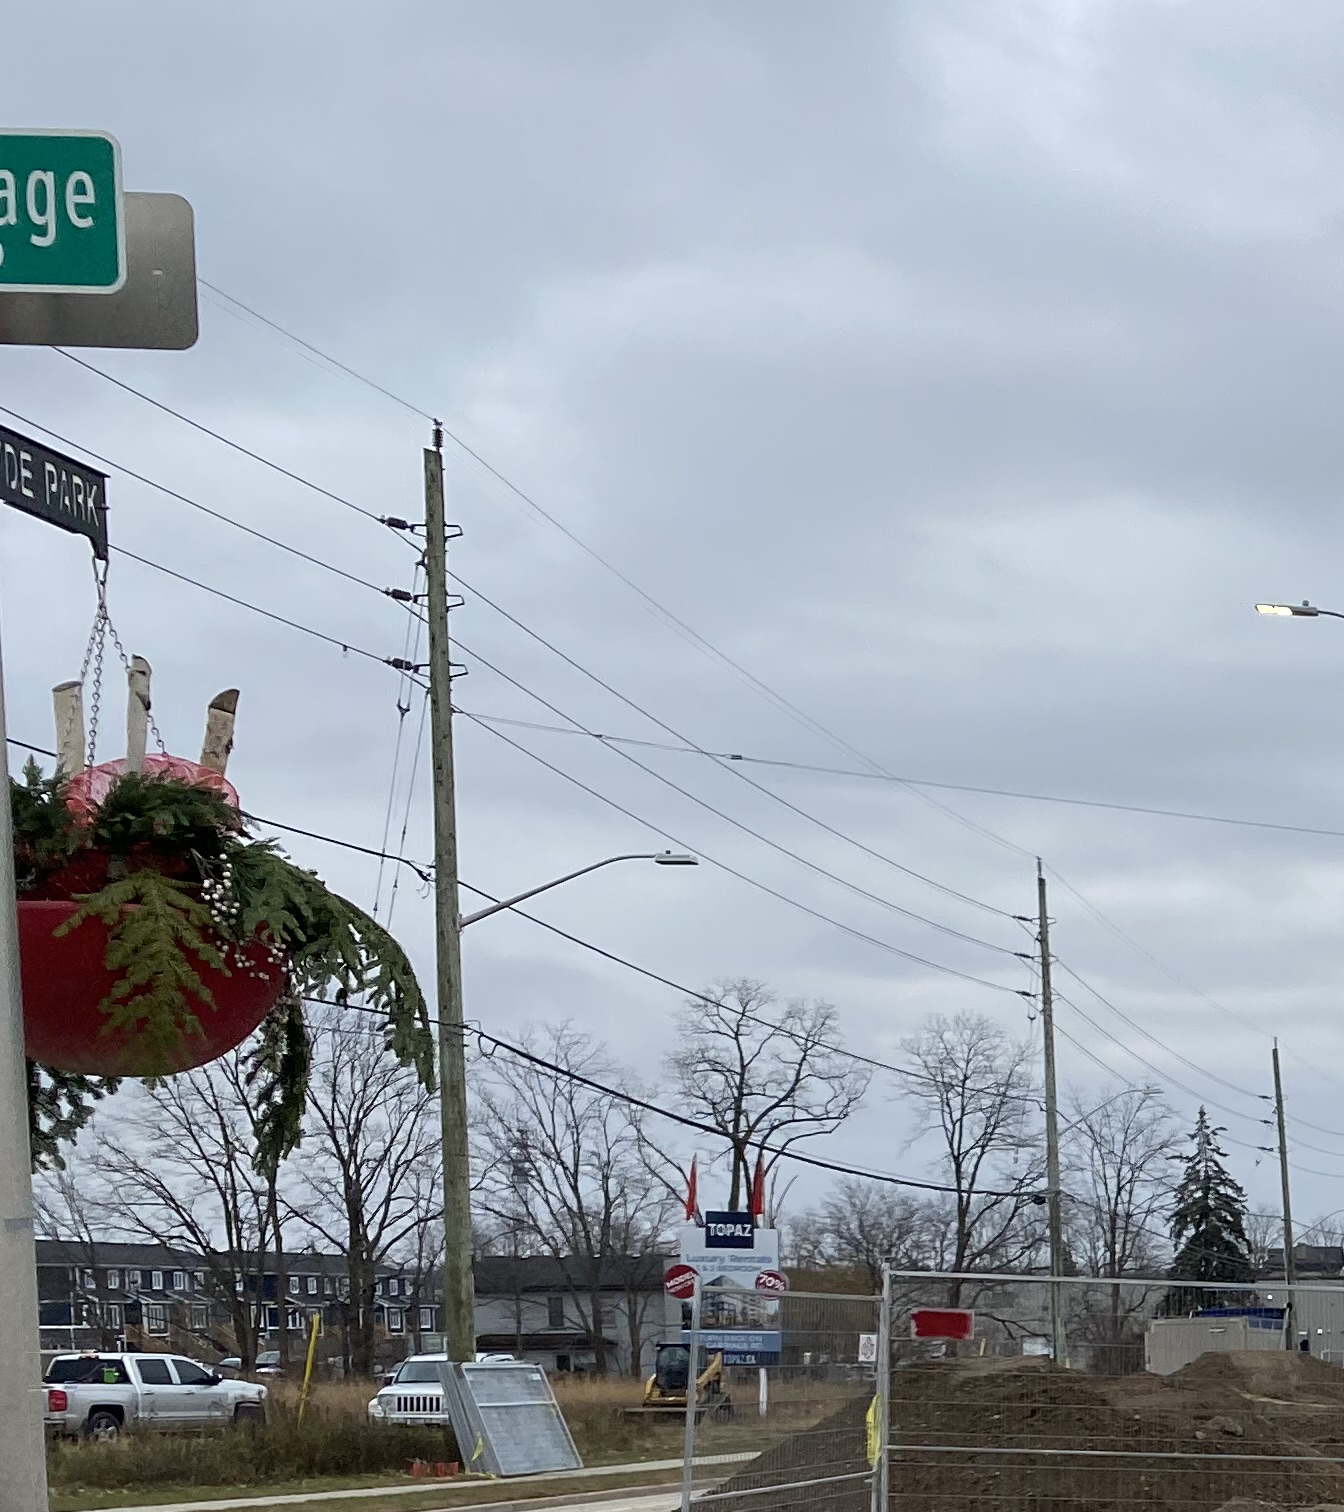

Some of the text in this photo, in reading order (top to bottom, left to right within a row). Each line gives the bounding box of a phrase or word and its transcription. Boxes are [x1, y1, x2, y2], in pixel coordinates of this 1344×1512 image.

[44, 461, 99, 527] PARK
[707, 1223, 752, 1237] TOPAZ
[759, 1273, 785, 1292] 70%
